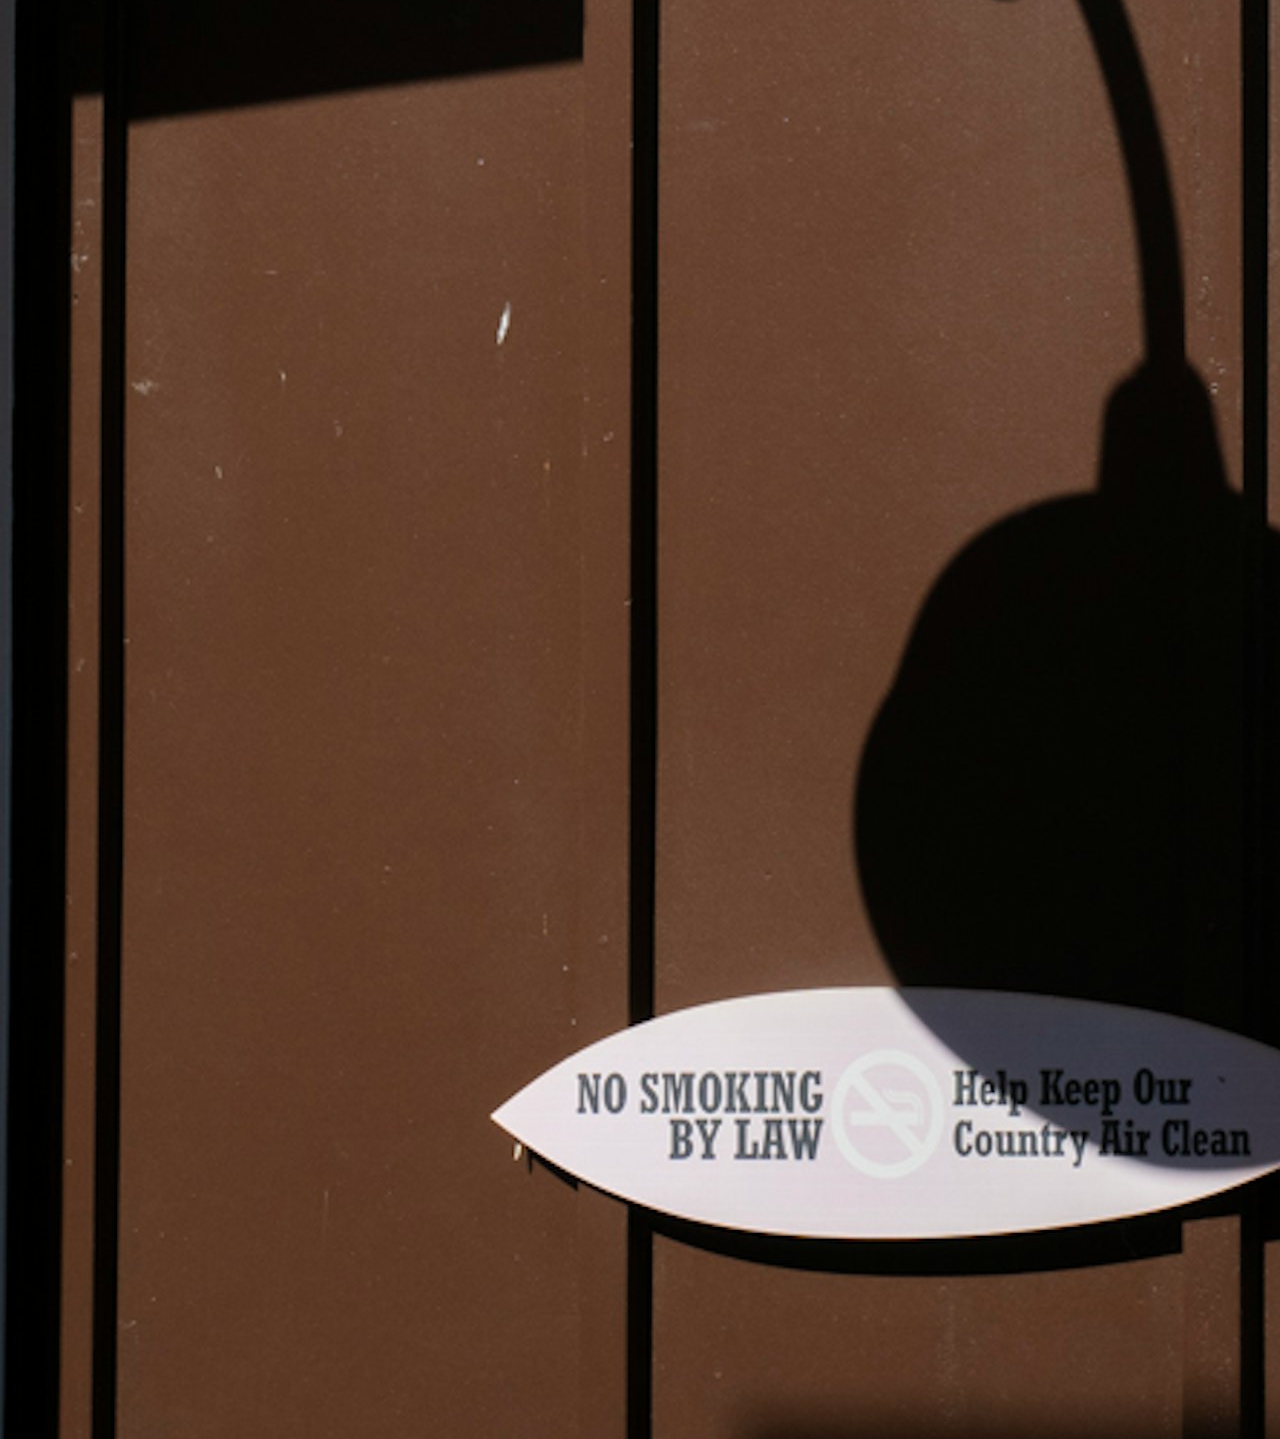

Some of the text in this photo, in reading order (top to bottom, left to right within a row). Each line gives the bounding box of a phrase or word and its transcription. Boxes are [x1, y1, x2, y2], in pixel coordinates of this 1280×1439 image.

[577, 1071, 823, 1114] NO SMOKING
[953, 1068, 1192, 1116] Help Keep Our
[669, 1119, 824, 1160] BY LAW
[953, 1120, 1251, 1167] Country Air Clean
